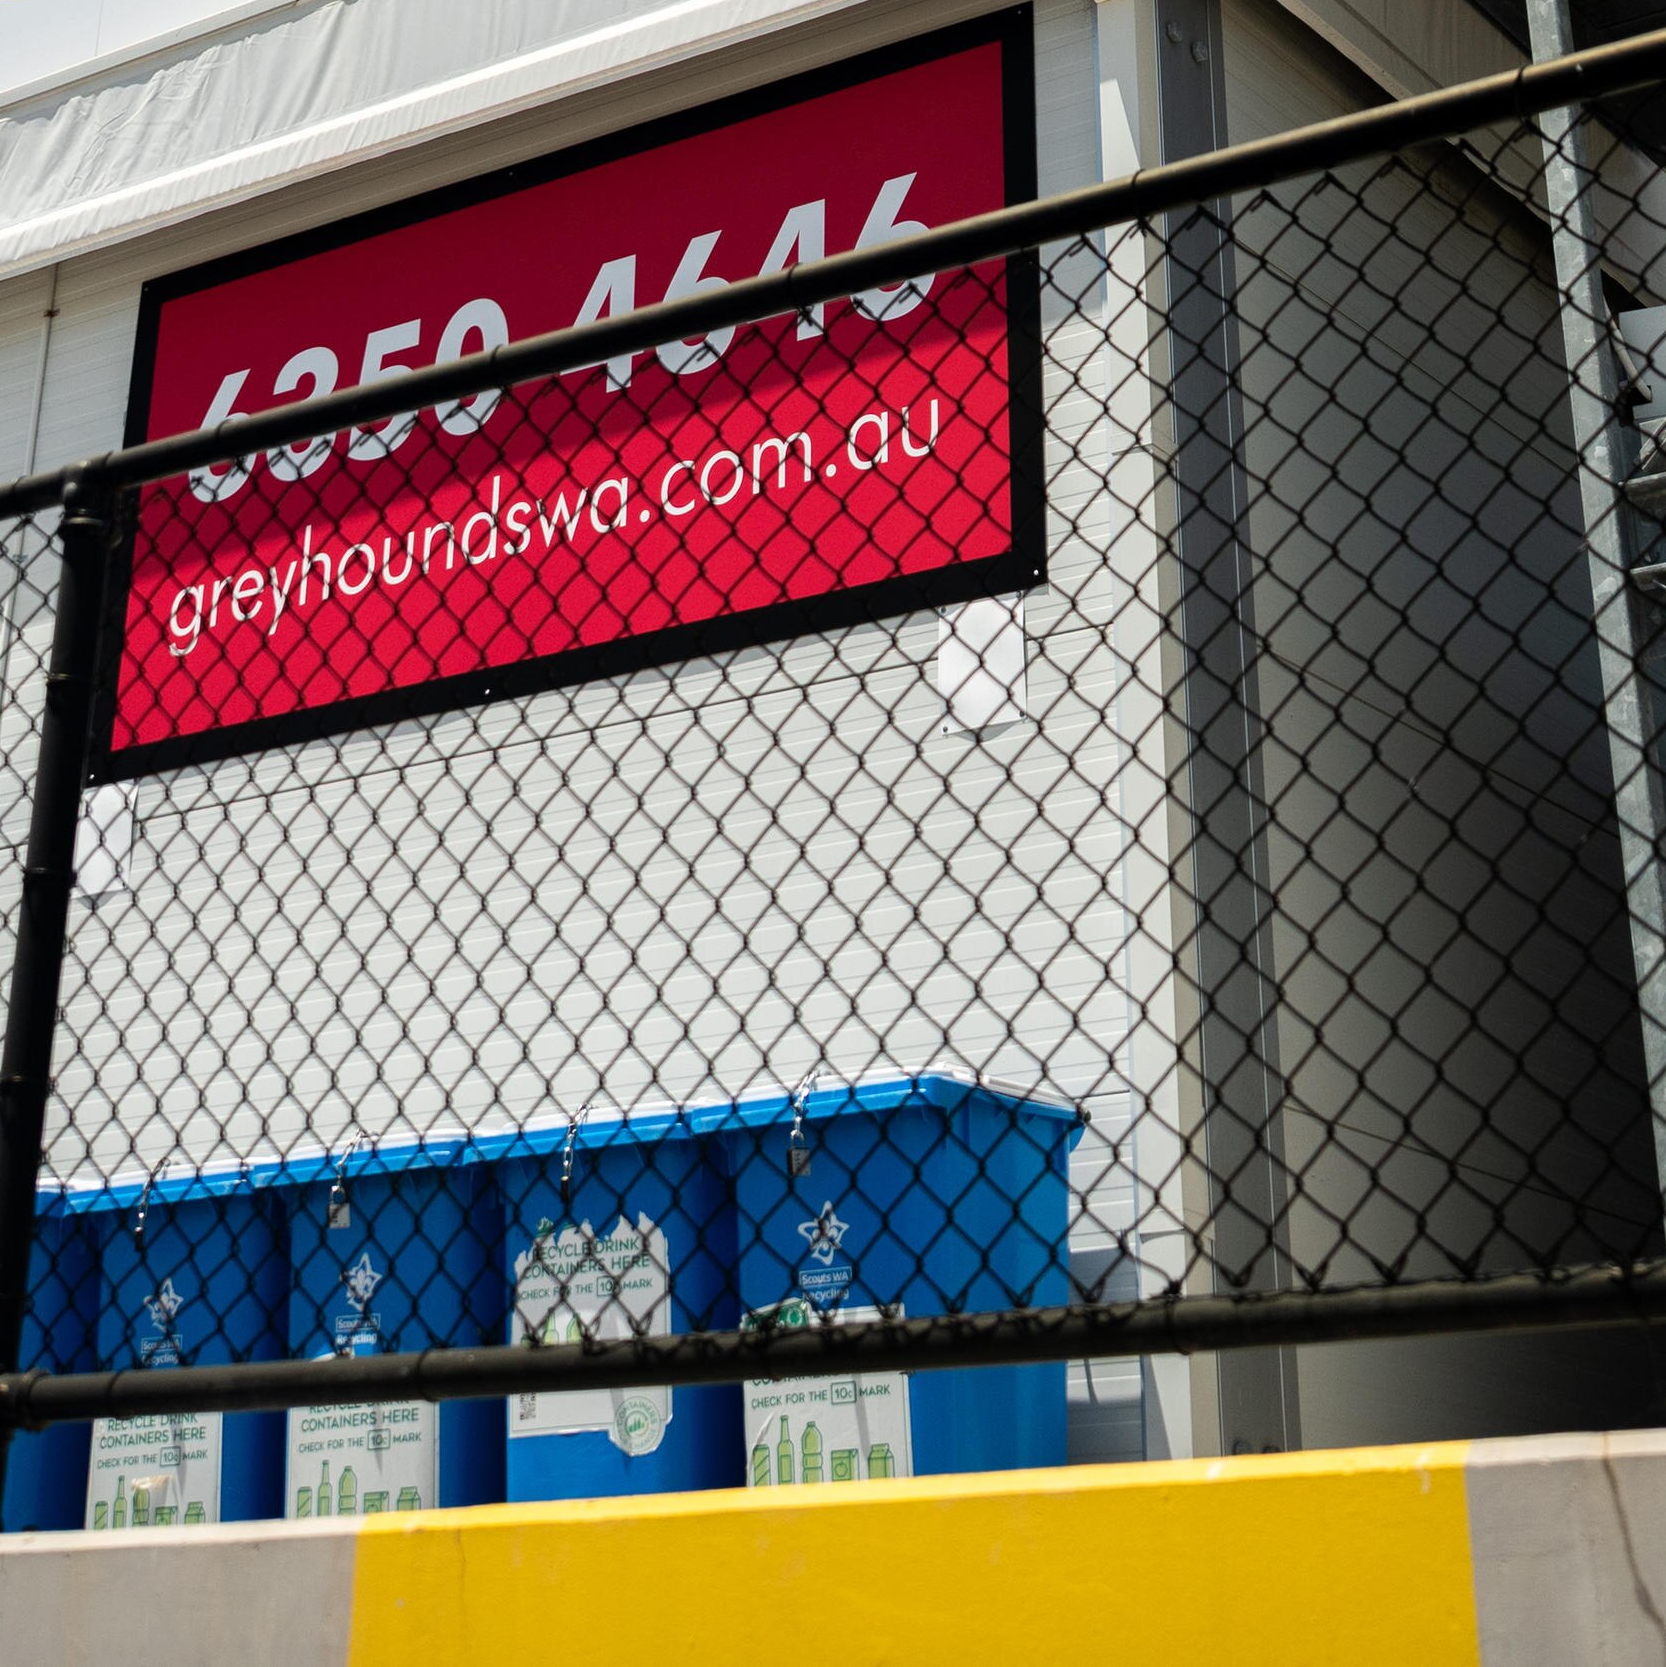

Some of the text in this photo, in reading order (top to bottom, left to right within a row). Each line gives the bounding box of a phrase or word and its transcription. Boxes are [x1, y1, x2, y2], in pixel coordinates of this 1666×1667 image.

[558, 172, 936, 393] 4646
[168, 399, 941, 657] greyhoundswa.com.au
[594, 1235, 639, 1254] DRINK
[611, 1253, 649, 1271] HERE
[553, 1285, 572, 1298] FR
[576, 1283, 594, 1295] THE
[623, 1278, 653, 1290] MARK
[802, 1271, 849, 1285] Scouts WA
[751, 1394, 782, 1410] CHECK
[786, 1391, 805, 1404] FOR
[808, 1389, 828, 1402] THE
[859, 1384, 890, 1397] MARK
[301, 1411, 377, 1433] CONTAINERS
[382, 1407, 420, 1424] HERE
[100, 1426, 206, 1450] CONTAINERS HERE
[299, 1441, 324, 1454] CHECK
[327, 1438, 344, 1451] FOR
[348, 1436, 364, 1448] THE
[393, 1431, 421, 1444] MARK
[97, 1457, 121, 1470] CHECK
[123, 1454, 140, 1466] FOR
[142, 1452, 157, 1465] THE
[182, 1449, 208, 1461] MARK
